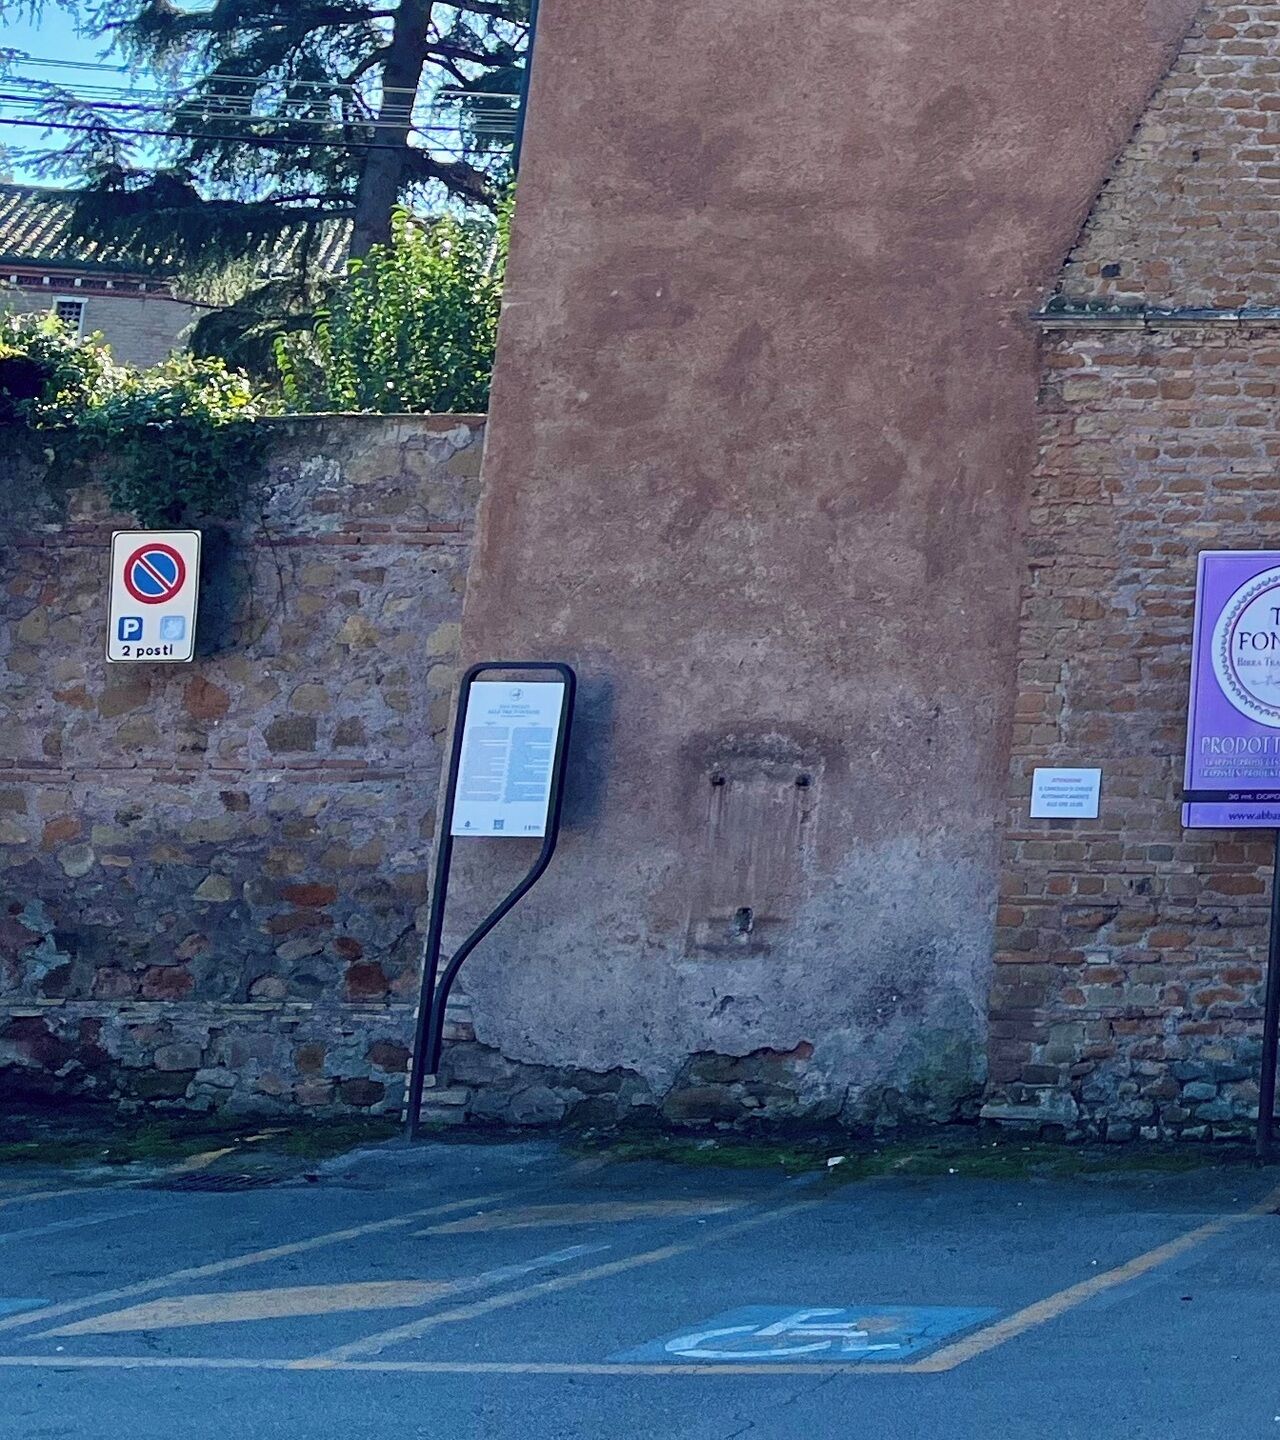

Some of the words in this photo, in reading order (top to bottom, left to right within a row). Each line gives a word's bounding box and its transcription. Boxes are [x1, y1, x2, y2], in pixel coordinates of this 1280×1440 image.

[122, 619, 140, 639] P
[122, 646, 130, 657] 2
[136, 644, 173, 658] posti
